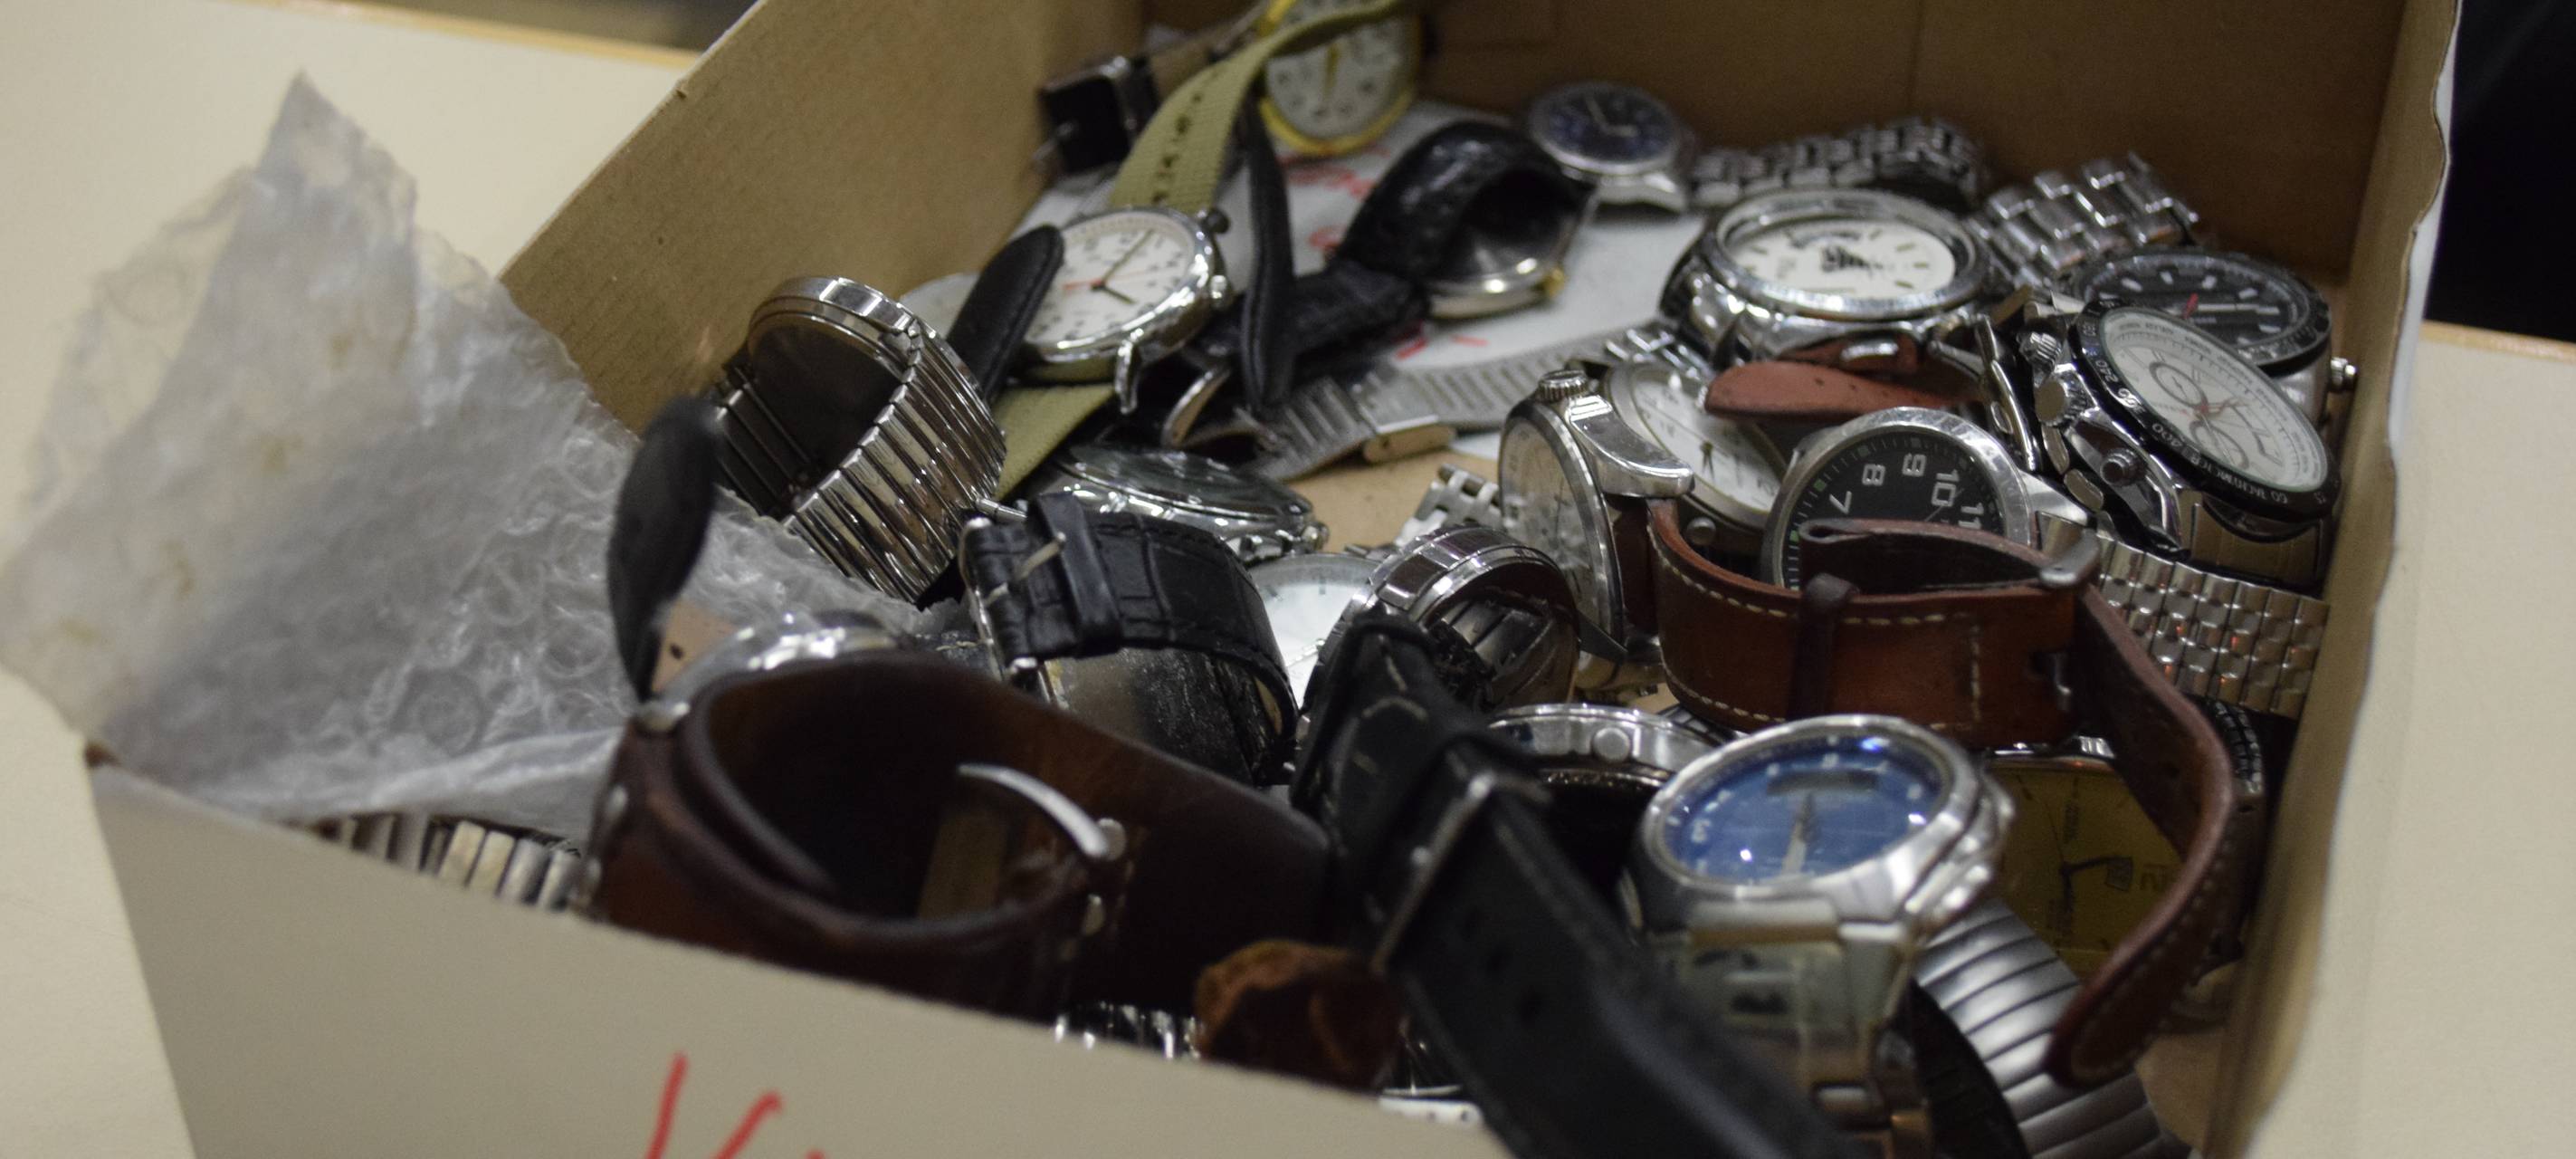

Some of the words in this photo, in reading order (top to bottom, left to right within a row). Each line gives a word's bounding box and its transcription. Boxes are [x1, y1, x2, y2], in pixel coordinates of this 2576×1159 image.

[2094, 359, 2119, 384] 240
[1861, 463, 1886, 487] 8
[1902, 453, 1927, 477] 9
[1931, 470, 1961, 508] 10
[1828, 490, 1854, 515] 7
[1957, 501, 1986, 530] 11
